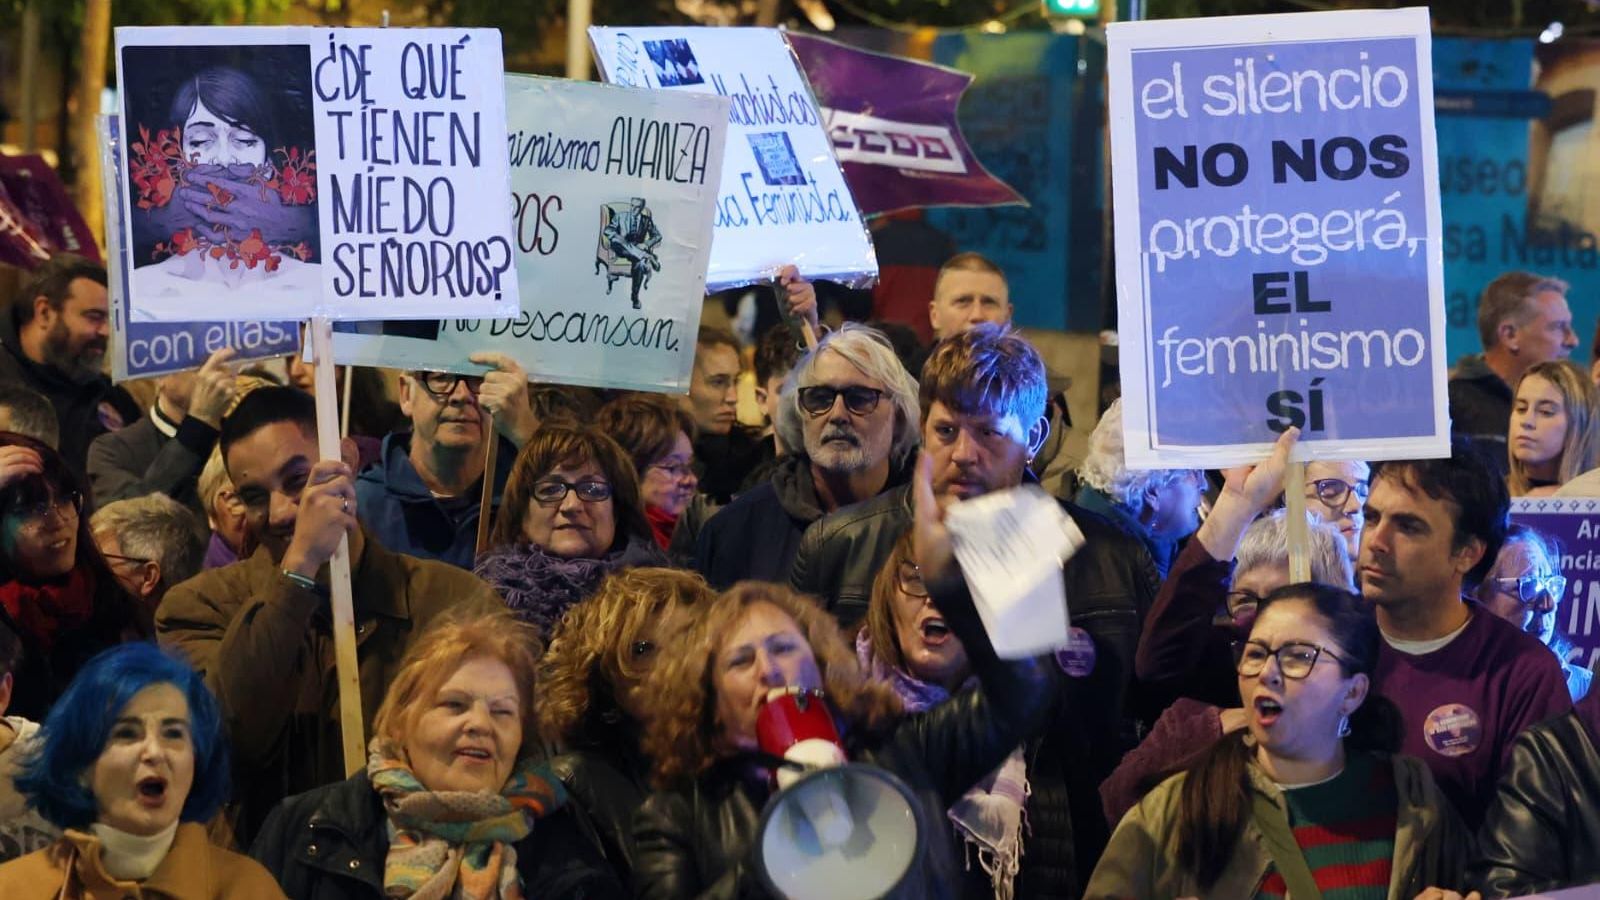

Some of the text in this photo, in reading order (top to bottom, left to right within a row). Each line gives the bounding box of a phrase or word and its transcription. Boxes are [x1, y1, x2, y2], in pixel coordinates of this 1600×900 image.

[315, 32, 471, 104] ¿DE QUÉ
[1141, 51, 1408, 119] el silencio
[605, 116, 711, 185] AVANZA
[1153, 133, 1411, 191] NO NOS
[1149, 190, 1419, 273] protegerá,
[333, 236, 512, 300] SEÑOROS?
[1252, 271, 1332, 315] EL
[128, 329, 195, 369] con
[1157, 319, 1425, 388] feminismo
[1265, 378, 1325, 435] SÍ
